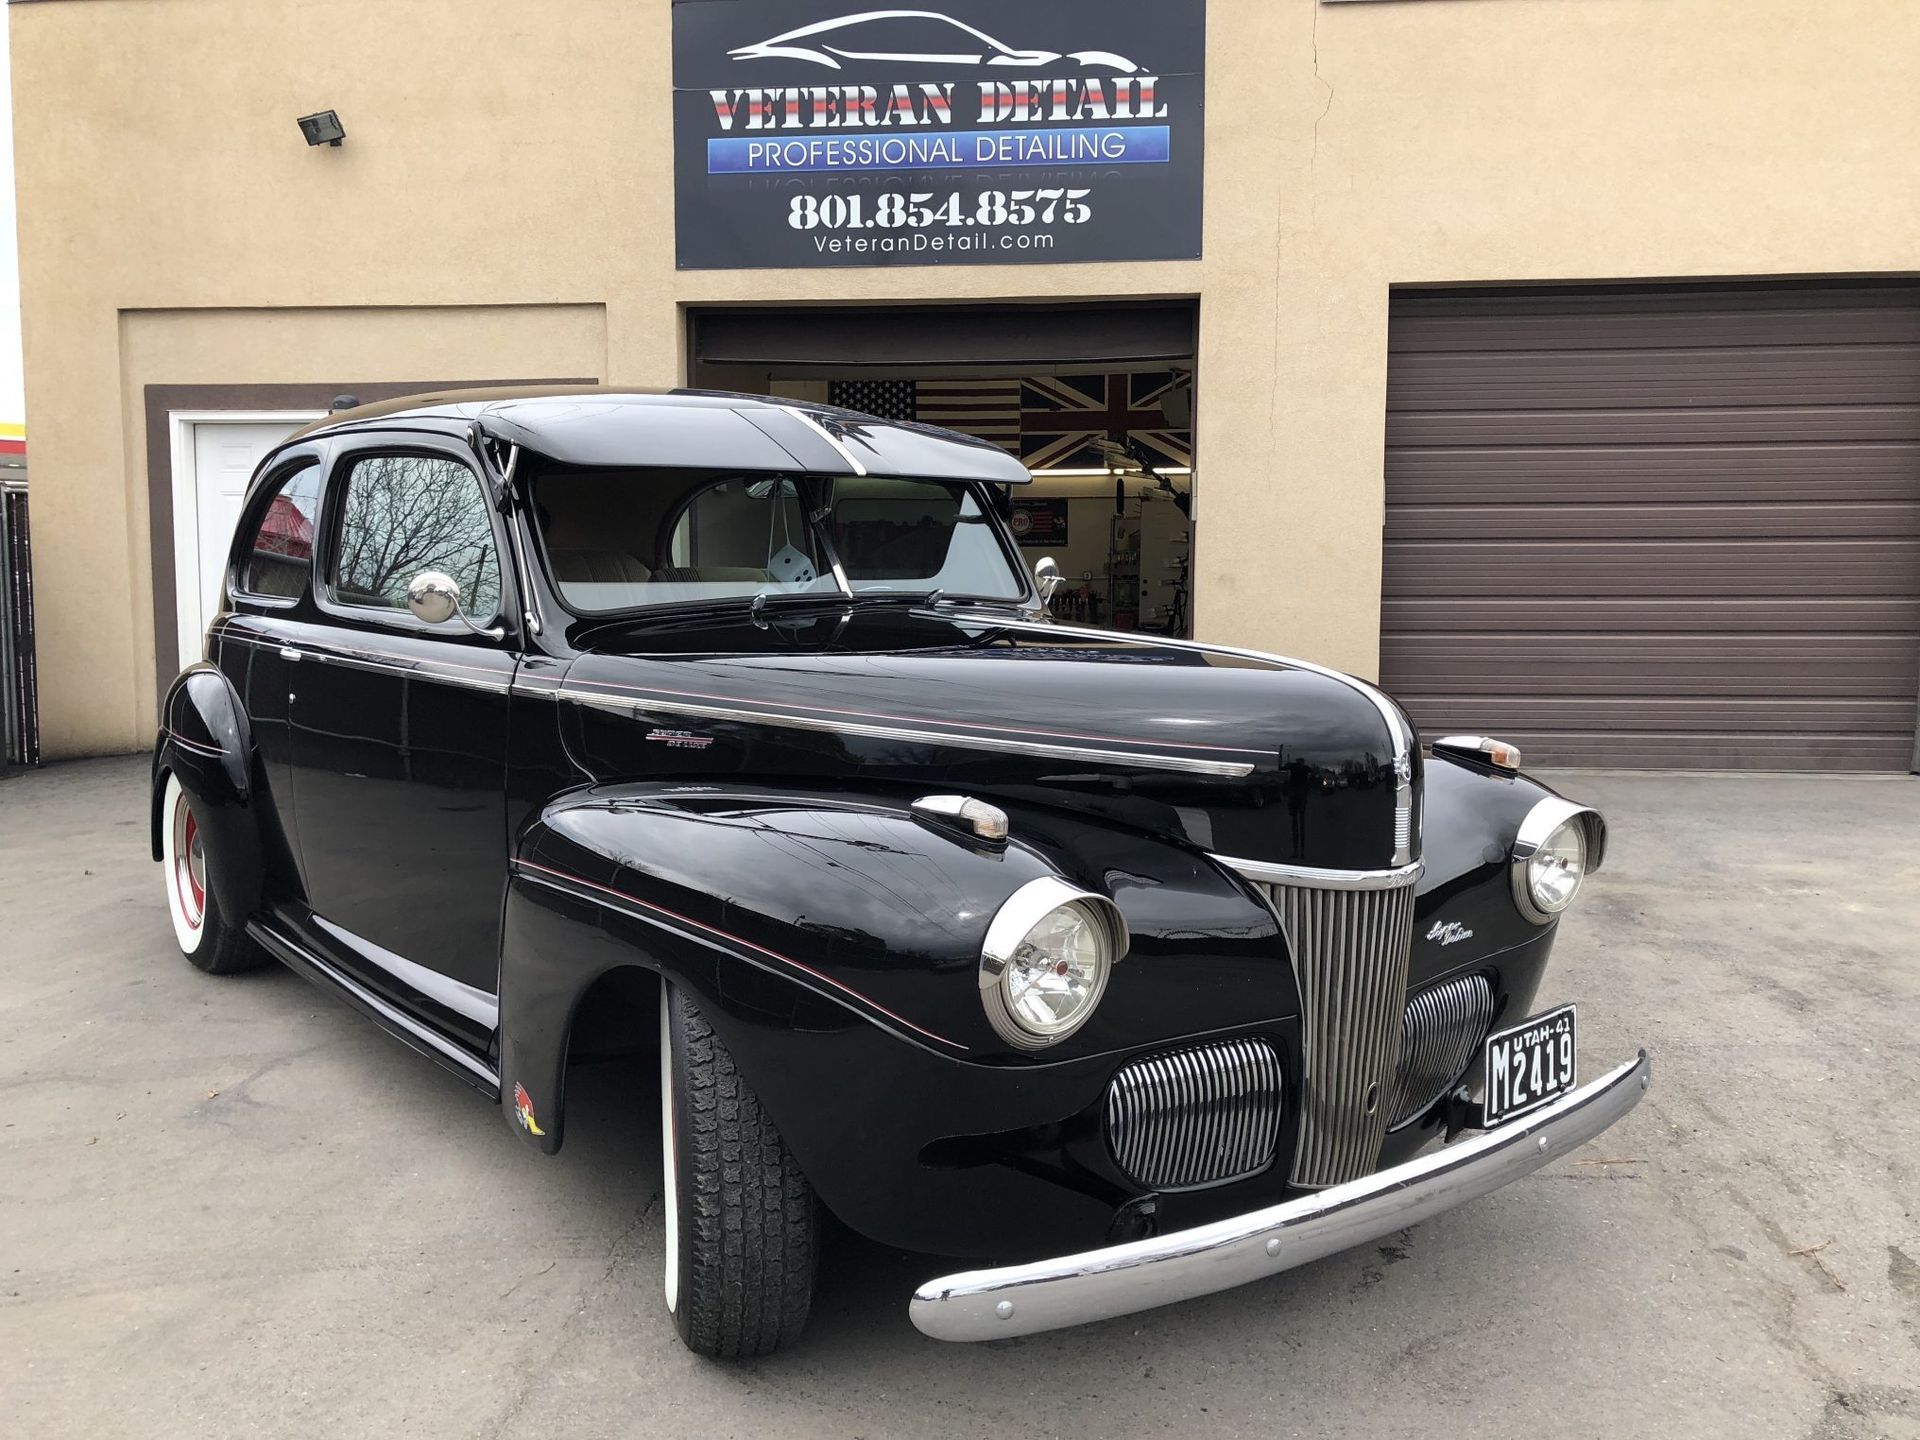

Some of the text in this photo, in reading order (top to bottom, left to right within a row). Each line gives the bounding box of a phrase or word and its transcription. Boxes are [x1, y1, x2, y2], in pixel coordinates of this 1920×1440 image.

[709, 76, 1168, 131] VETERAN DETAIL
[747, 131, 1126, 168] PROFESSIONAL DETAILING
[787, 187, 1092, 230] 801.854.8575
[813, 232, 1055, 254] VeteranDetail.com
[1513, 1017, 1571, 1052] UTAH-41
[1491, 1032, 1572, 1115] M2419
